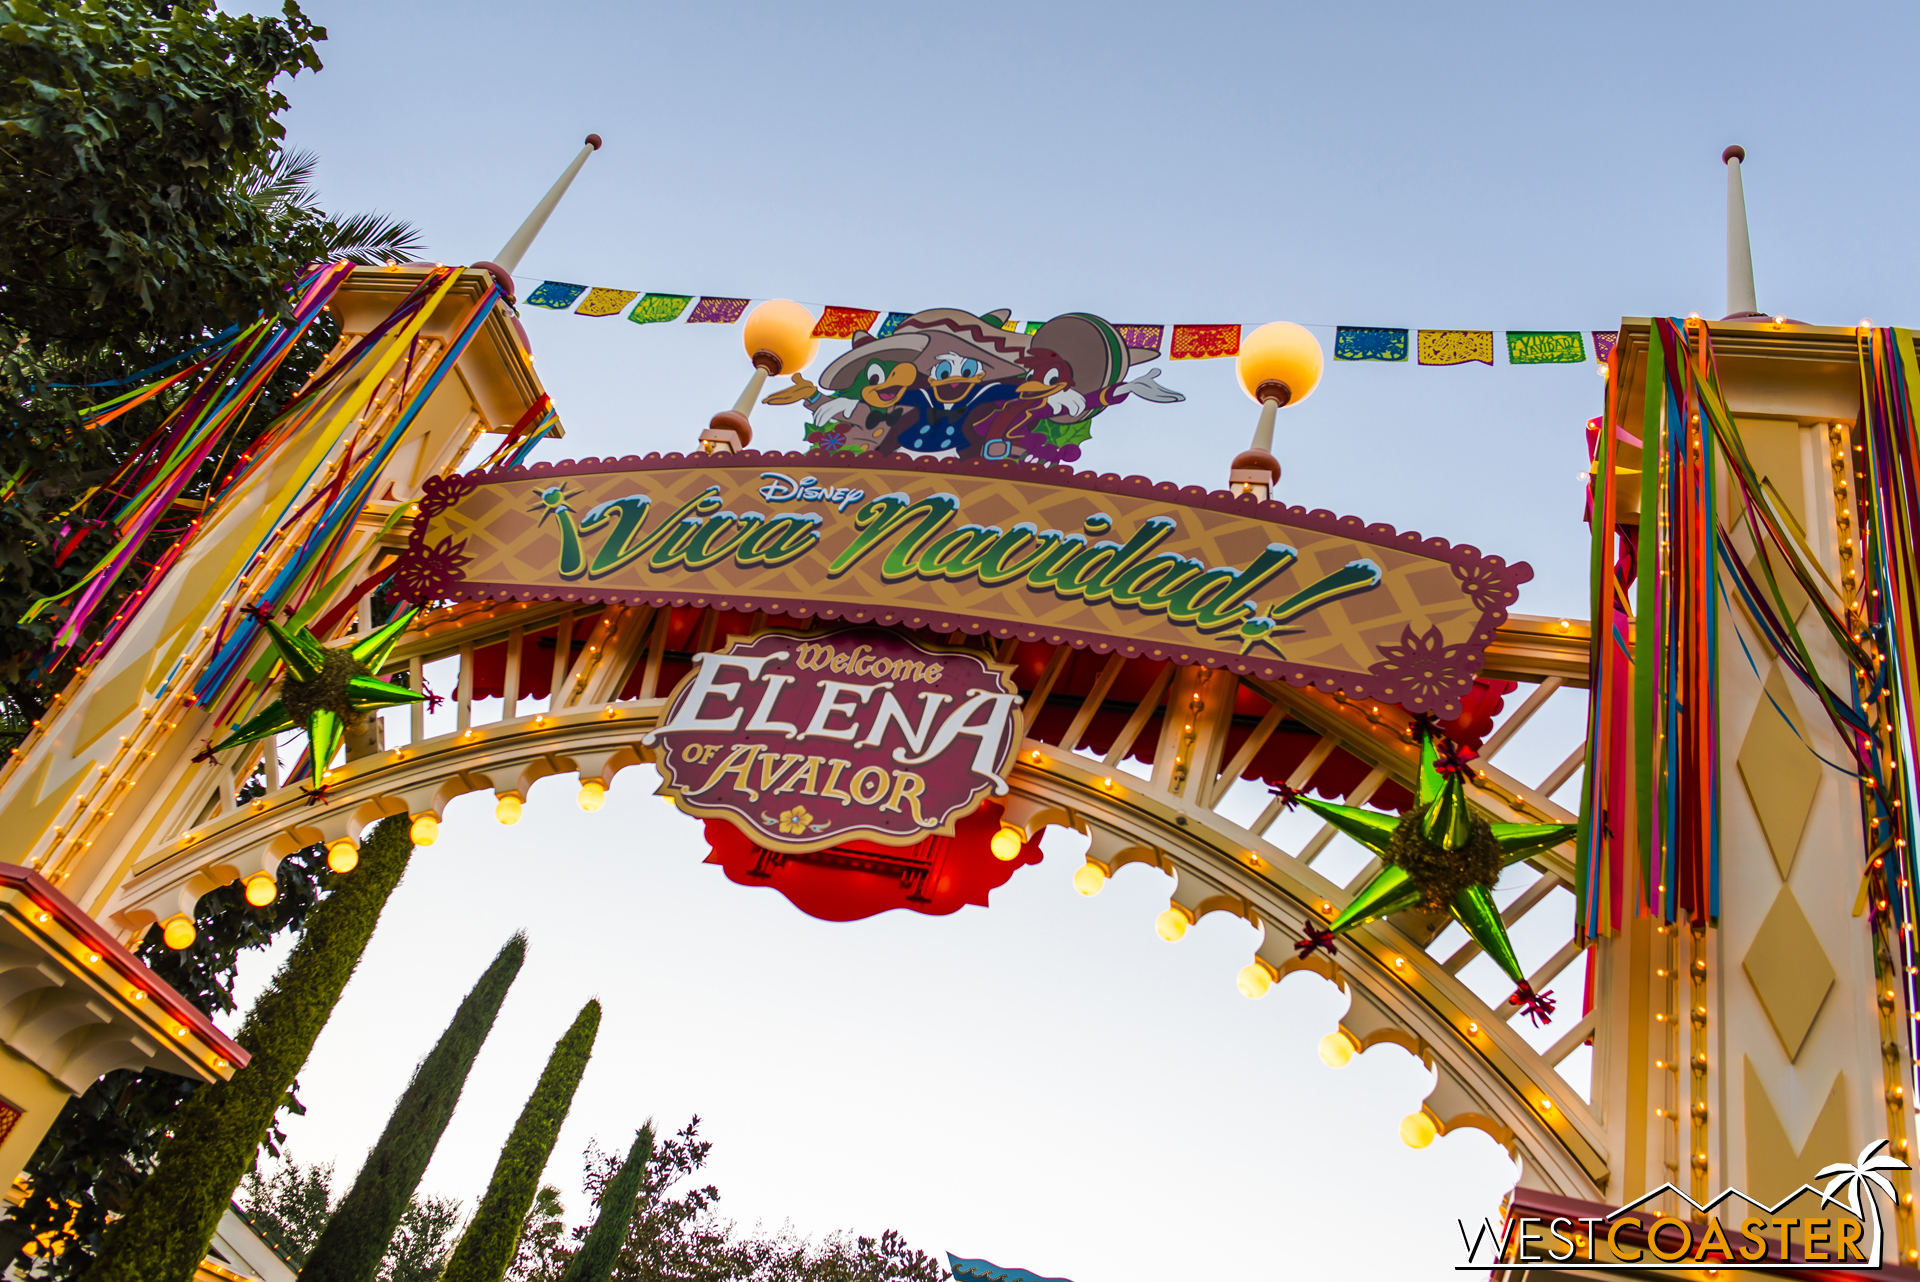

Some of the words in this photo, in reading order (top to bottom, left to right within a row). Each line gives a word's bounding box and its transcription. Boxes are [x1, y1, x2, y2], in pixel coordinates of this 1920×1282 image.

[827, 491, 1382, 645] Navidad!
[796, 642, 944, 685] Welcome
[641, 650, 1024, 797] ELENA
[681, 742, 724, 765] OF
[681, 743, 939, 828] AVALOR
